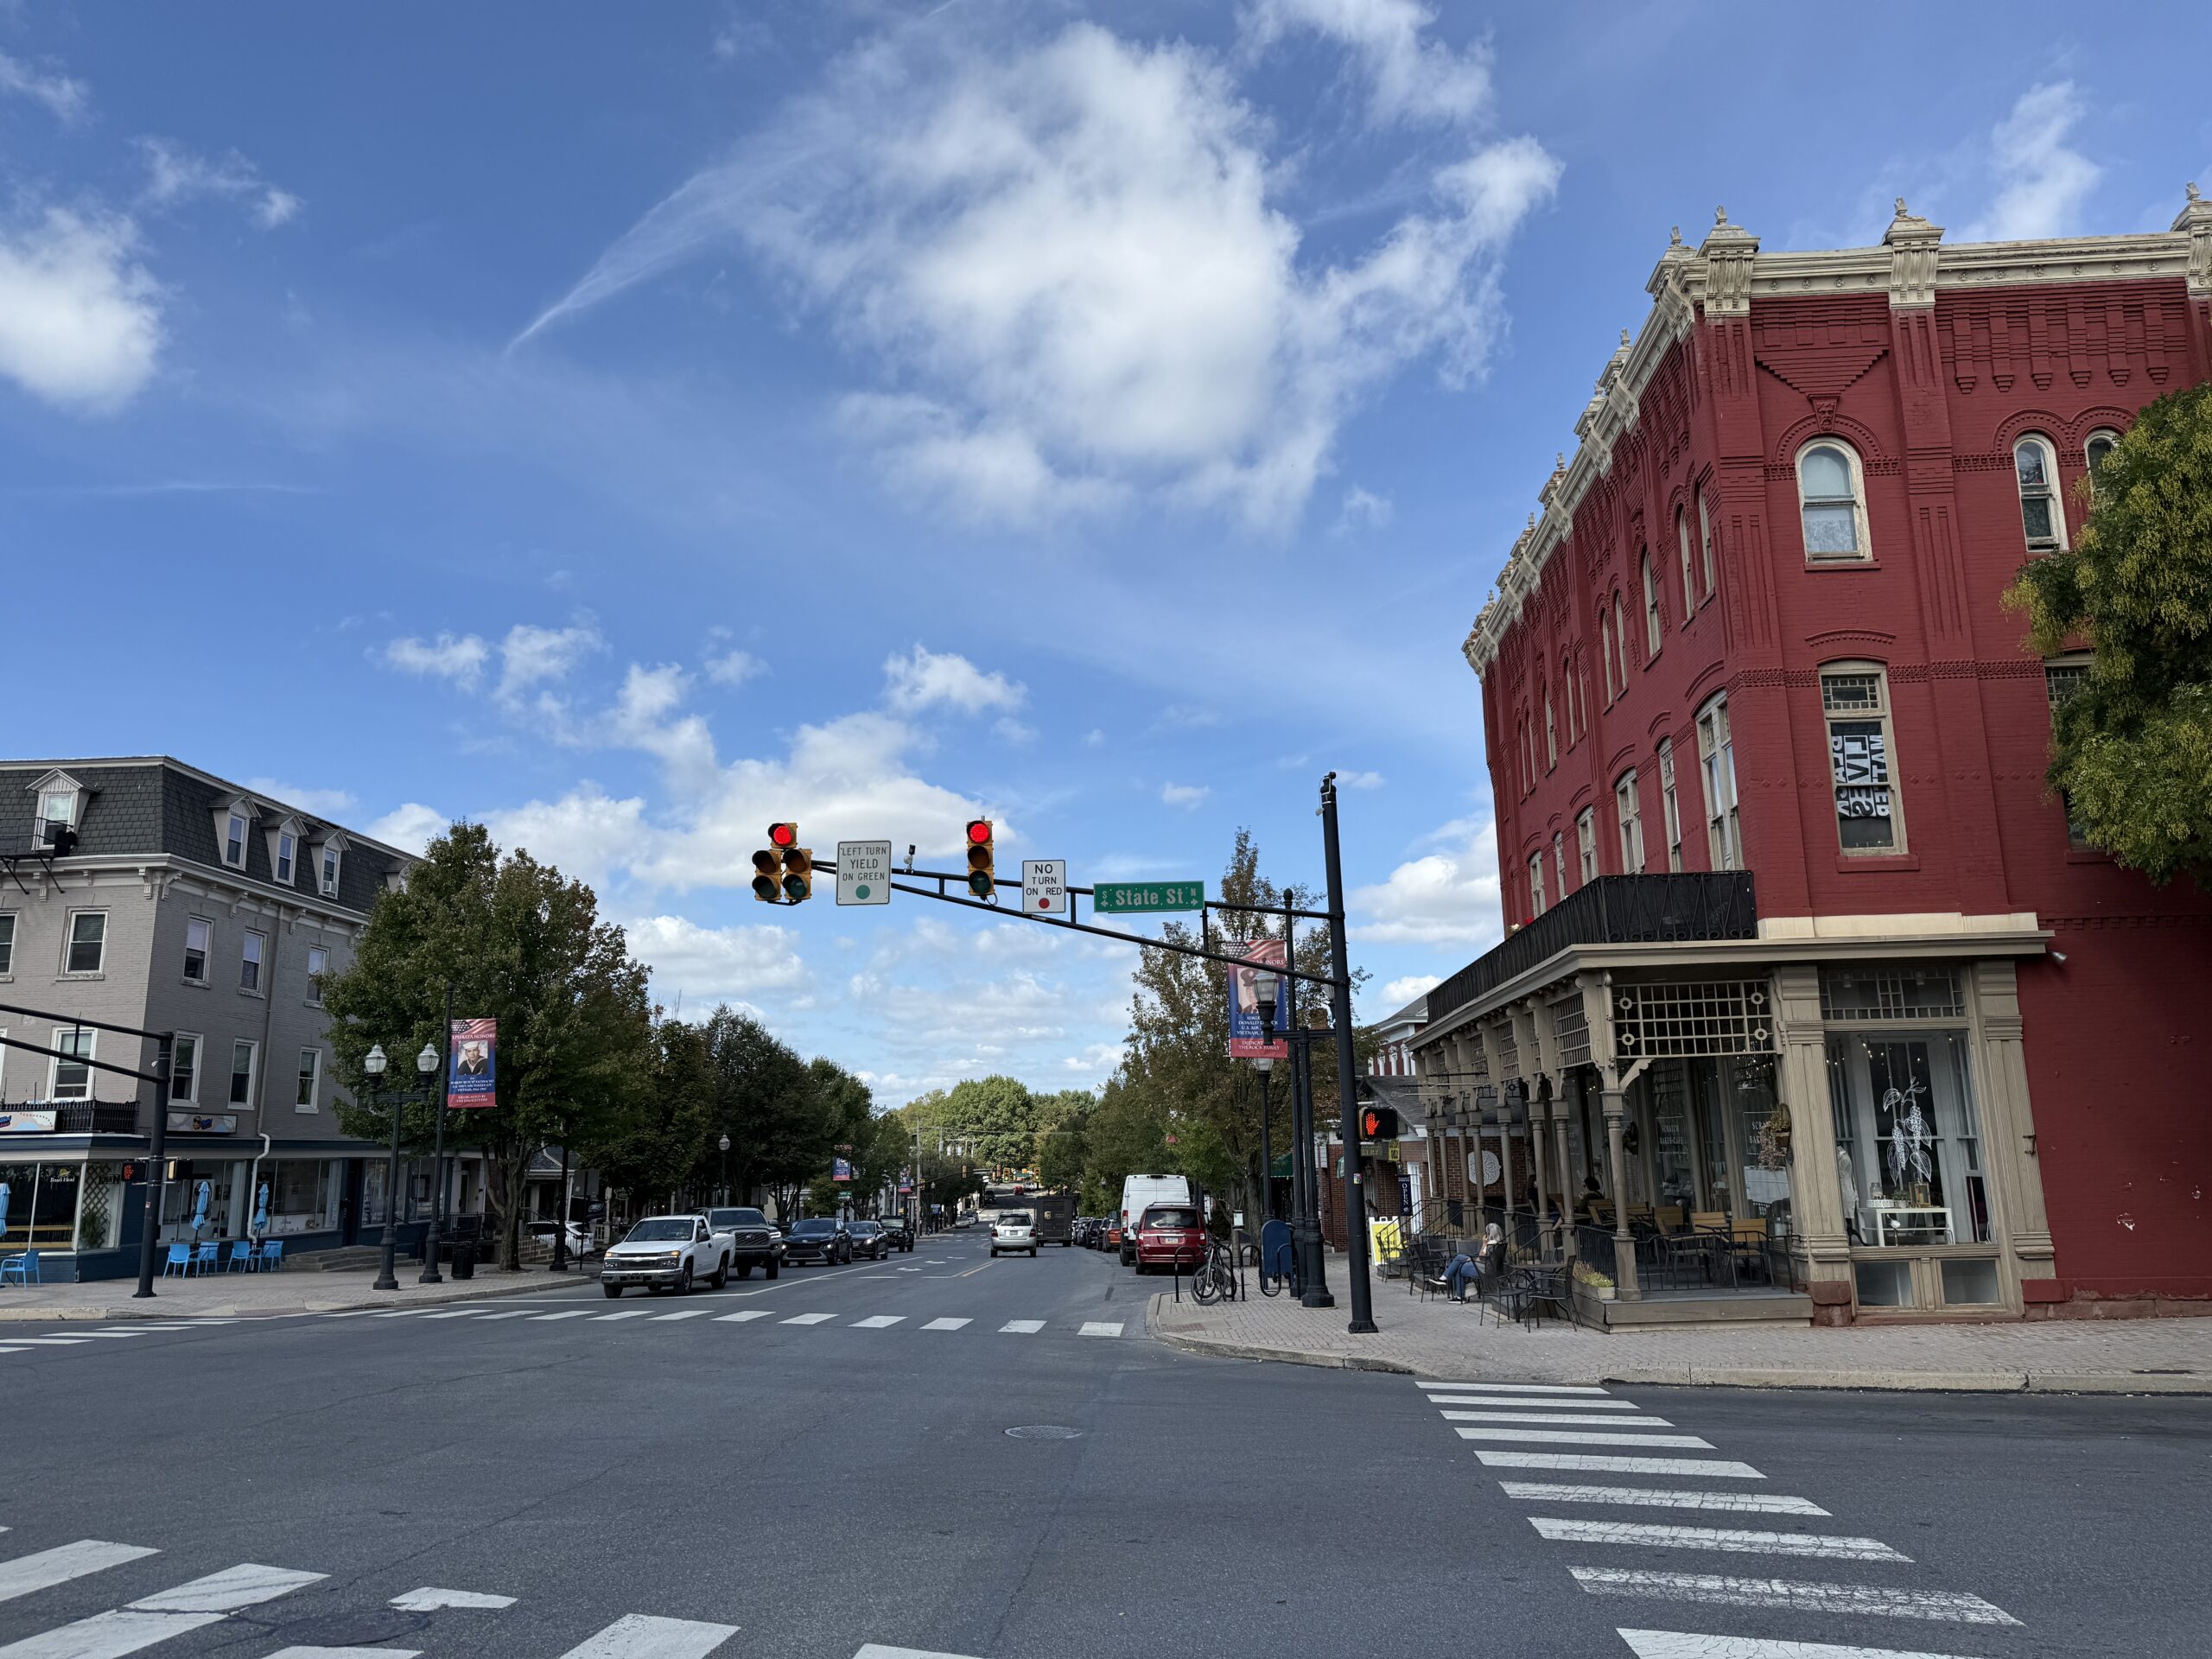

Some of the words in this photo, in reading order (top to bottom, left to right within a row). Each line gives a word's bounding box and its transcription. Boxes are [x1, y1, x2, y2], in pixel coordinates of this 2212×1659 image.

[842, 847, 861, 855] LEFT
[866, 847, 887, 855] TURN
[850, 859, 878, 869] YIELD
[1035, 864, 1053, 874] NO
[842, 873, 854, 881] ON
[858, 872, 885, 881] GREEN
[1032, 876, 1057, 885] TURN
[1026, 887, 1039, 896] ON
[1046, 887, 1063, 896] RED
[1102, 890, 1107, 899] S
[1191, 887, 1197, 897] N
[1116, 889, 1159, 906] State
[1166, 888, 1184, 904] St
[1661, 1124, 1679, 1133] SCRATCH
